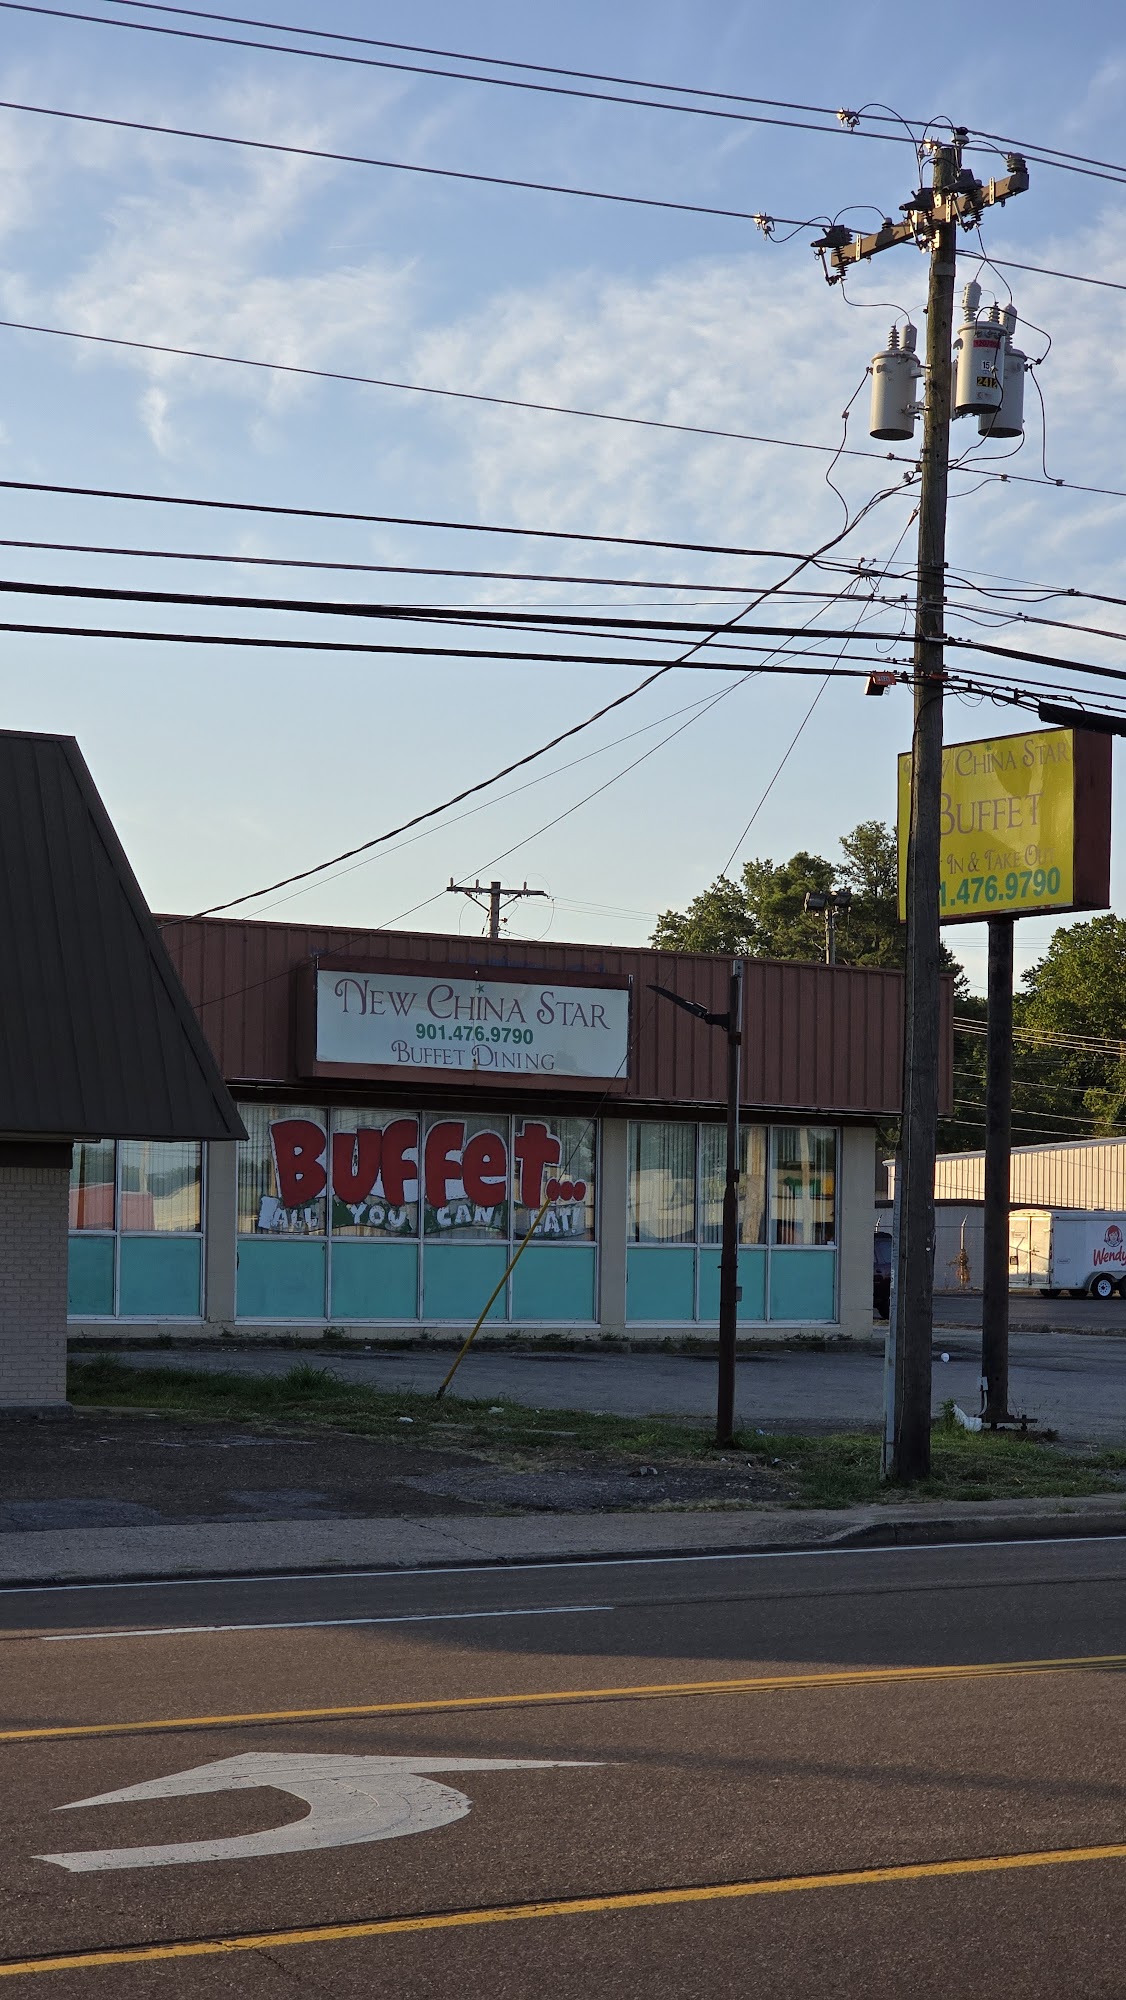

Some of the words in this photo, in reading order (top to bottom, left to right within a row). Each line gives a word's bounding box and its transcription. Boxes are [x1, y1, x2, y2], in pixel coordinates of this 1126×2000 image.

[982, 361, 991, 370] 15
[956, 748, 1017, 777] CHINA
[1022, 739, 1071, 768] STAR
[940, 791, 1044, 836] BUFFET
[968, 851, 980, 873] &
[984, 849, 1021, 871] TAKE
[939, 866, 1060, 907] 1.476.9790
[334, 978, 418, 1017] NEW
[427, 984, 526, 1023] CHINA
[537, 990, 612, 1030] STAR
[415, 1023, 534, 1045] 901.476.9790
[391, 1039, 466, 1065] BUFFET
[471, 1044, 555, 1071] DINING
[271, 1207, 318, 1231] ALL
[348, 1202, 408, 1228] YOU
[437, 1204, 496, 1227] CAN
